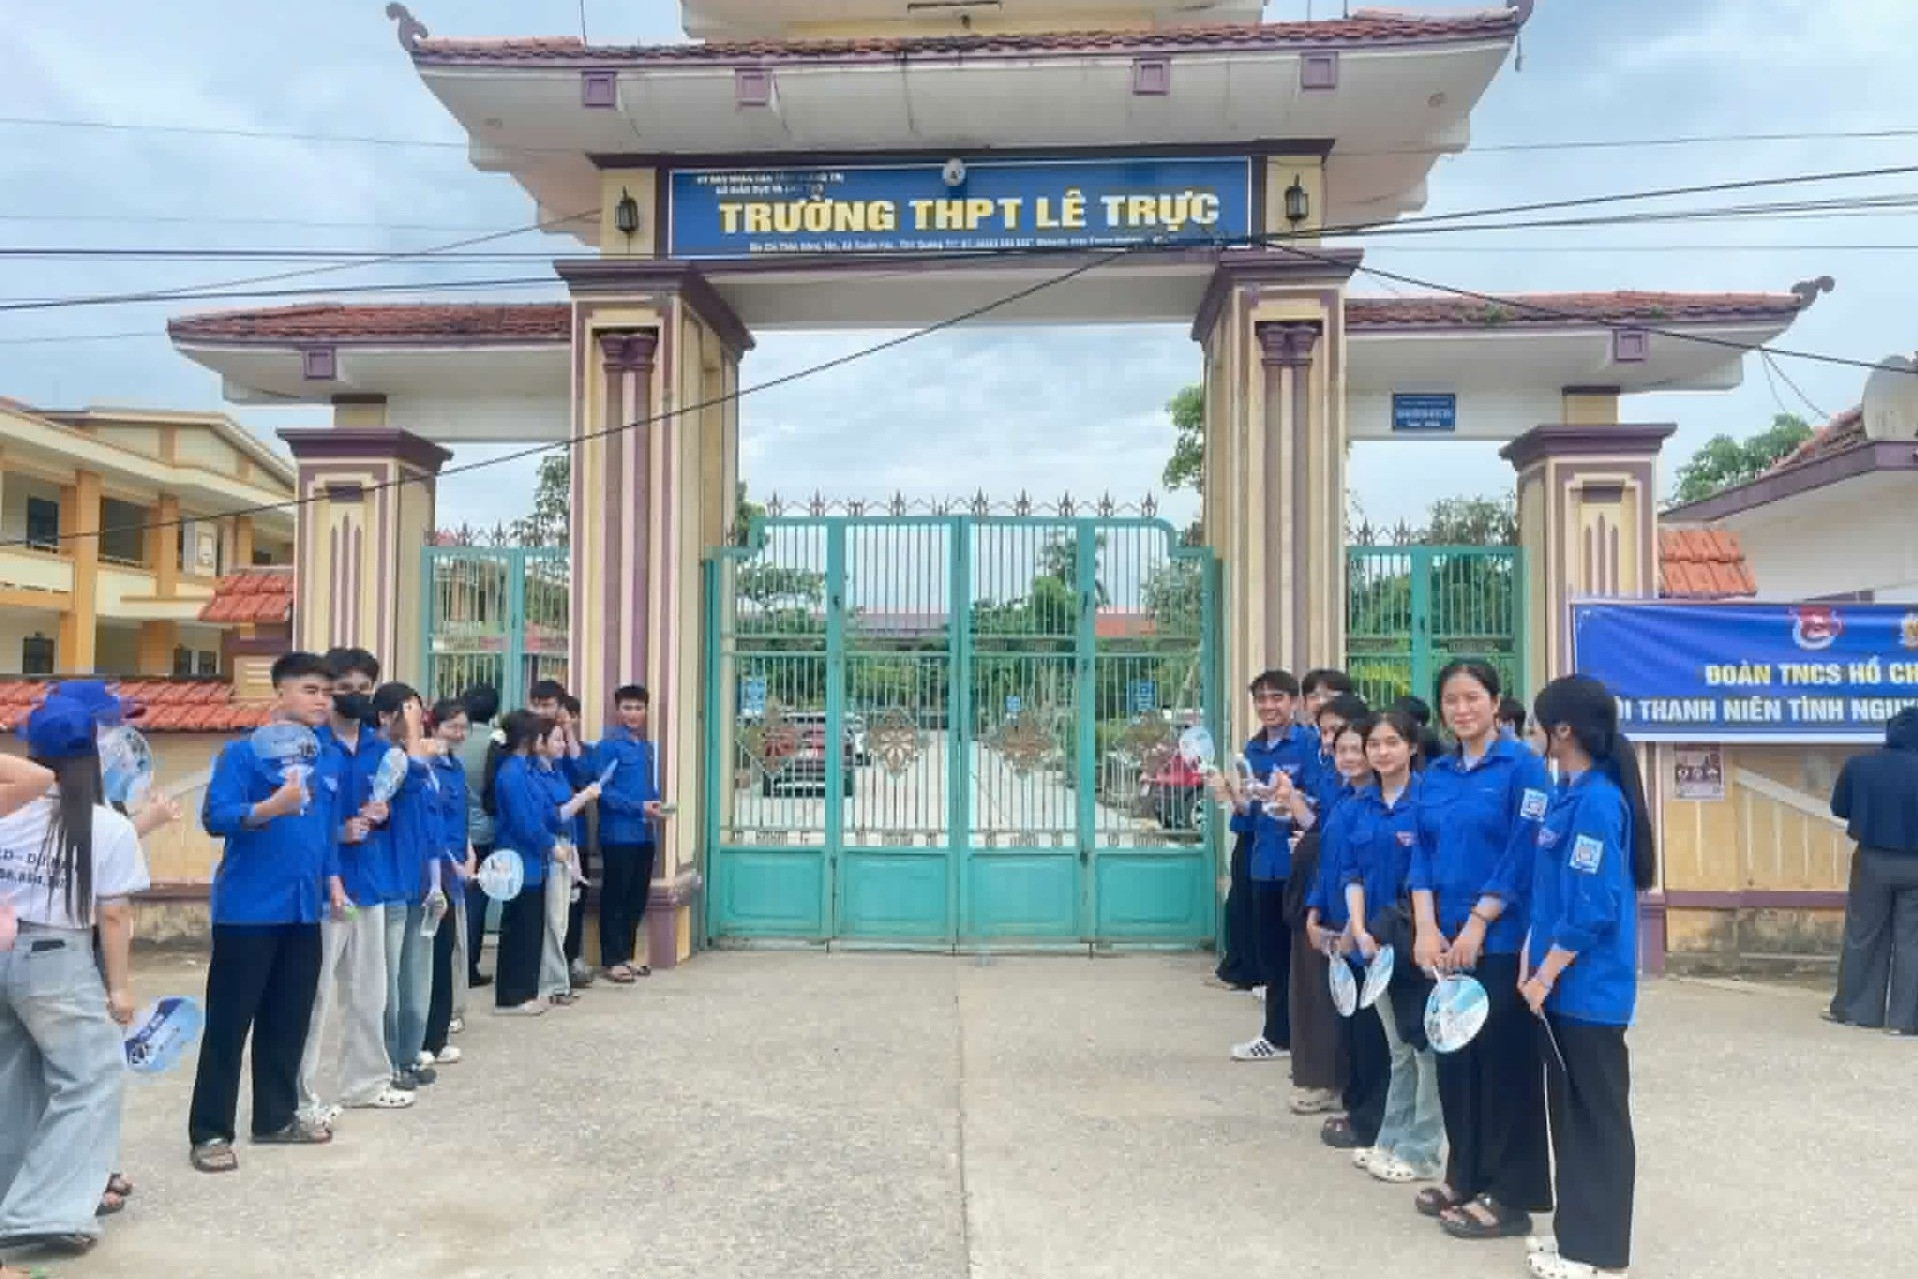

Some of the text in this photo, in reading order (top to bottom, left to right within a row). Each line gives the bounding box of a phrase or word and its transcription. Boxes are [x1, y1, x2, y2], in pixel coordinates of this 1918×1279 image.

[718, 188, 1220, 232] TRƯỜNG THPT LÊ TRỰC
[1704, 658, 1771, 686] ĐOÀN
[1777, 664, 1843, 685] TNCS
[1638, 698, 1717, 721] THANH
[1723, 695, 1782, 722] NIÊN
